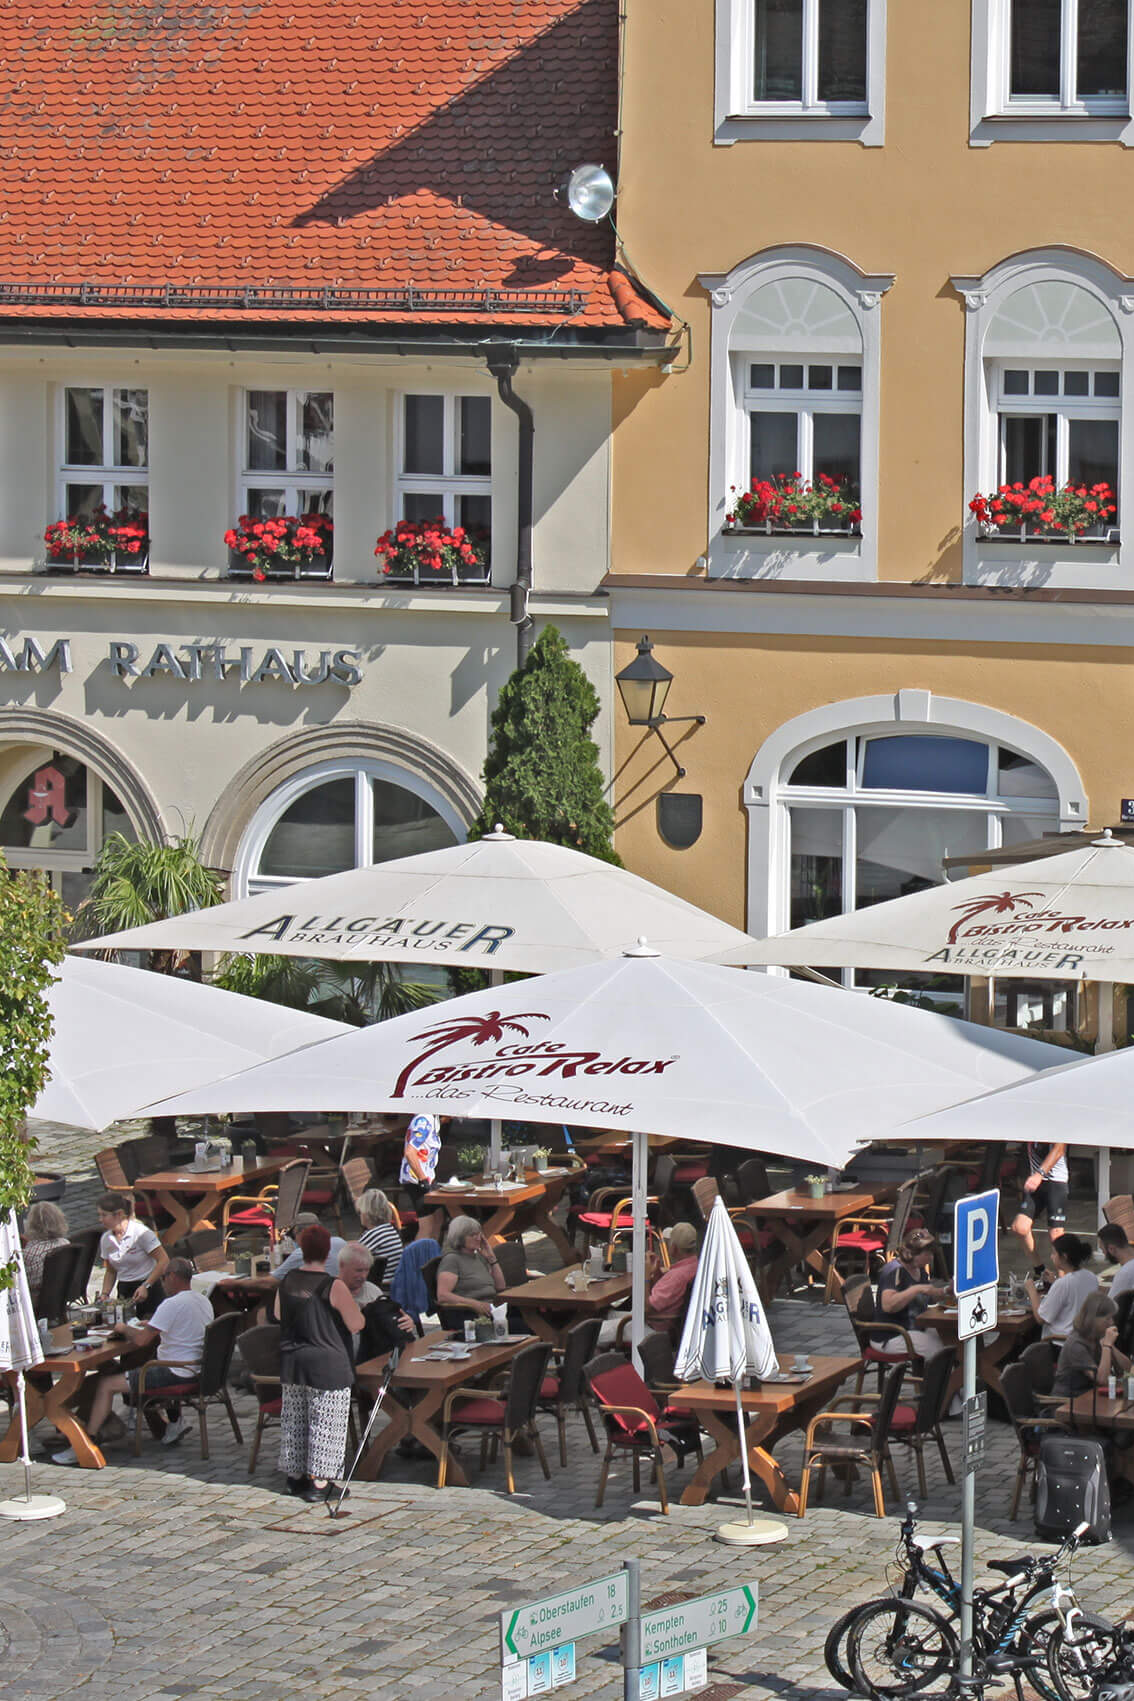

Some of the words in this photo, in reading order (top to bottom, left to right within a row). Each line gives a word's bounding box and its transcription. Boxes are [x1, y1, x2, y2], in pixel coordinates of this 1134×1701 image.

[109, 641, 363, 686] RATHAUS
[235, 914, 516, 955] ALLGÄUER
[287, 932, 453, 952] BRAUHAUS
[961, 923, 1042, 938] Bistro
[1008, 937, 1116, 955] Restaurant
[411, 1063, 536, 1087] Bistro
[536, 1052, 676, 1079] Relax
[481, 1084, 634, 1116] Restaurant
[966, 1208, 989, 1280] P
[539, 1594, 595, 1624] Oberstaufen
[607, 1584, 616, 1600] 18
[644, 1614, 684, 1636] Kempten
[717, 1600, 728, 1614] 25
[530, 1626, 563, 1648] Alpsee
[653, 1629, 698, 1655] Sonthofen
[718, 1619, 727, 1633] 10
